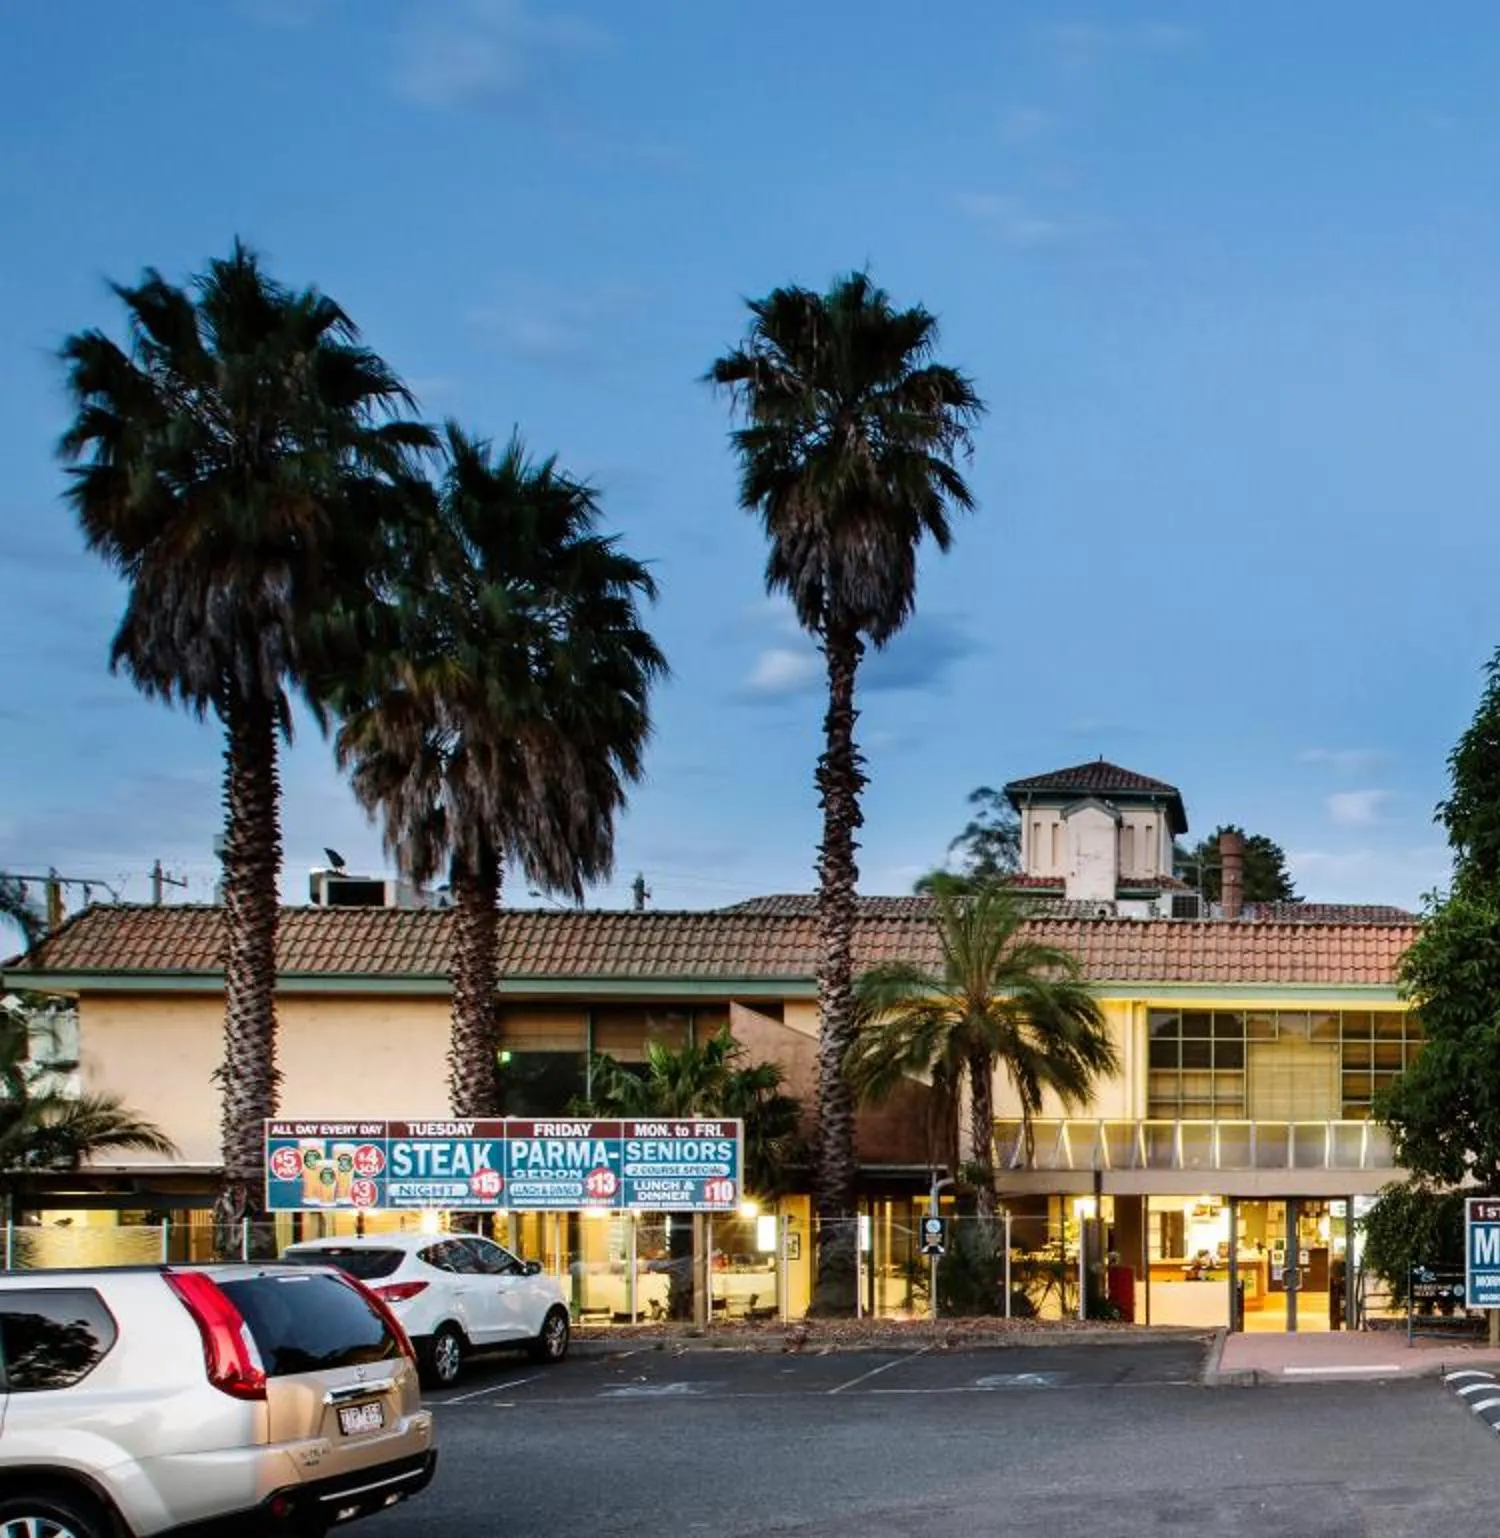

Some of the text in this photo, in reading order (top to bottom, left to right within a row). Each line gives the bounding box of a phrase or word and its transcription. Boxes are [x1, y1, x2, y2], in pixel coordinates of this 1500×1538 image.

[271, 1123, 383, 1135] ALL DAY EVERY DAY
[406, 1123, 475, 1136] TUESDAY
[533, 1123, 592, 1136] FRIDAY
[634, 1124, 672, 1137] MON.
[675, 1125, 689, 1137] to
[511, 1141, 619, 1168] PARMA-
[626, 1141, 733, 1161] SENIORS
[392, 1143, 493, 1176] STEAK
[512, 1169, 583, 1179] GEDON
[471, 1173, 501, 1194] $15
[587, 1172, 616, 1195] $13
[633, 1180, 680, 1191] LUNCH
[400, 1185, 455, 1197] NIGHT
[637, 1191, 691, 1201] DINNER
